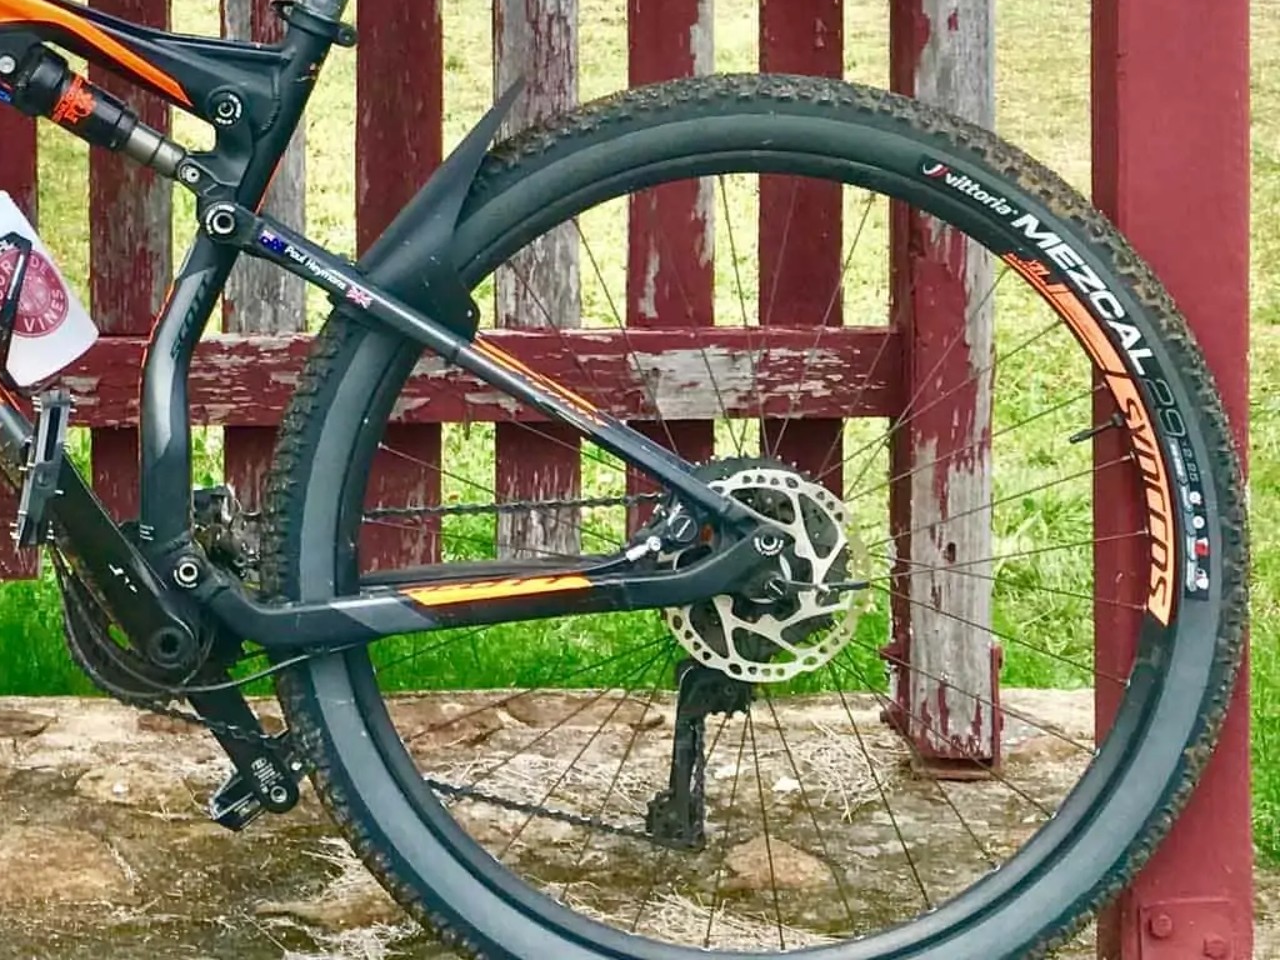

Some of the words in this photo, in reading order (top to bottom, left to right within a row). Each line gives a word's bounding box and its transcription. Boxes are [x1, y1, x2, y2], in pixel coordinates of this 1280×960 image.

[943, 171, 1010, 216] vittoria
[1014, 212, 1157, 376] MEZCAL
[1124, 396, 1169, 608] SYNCROS
